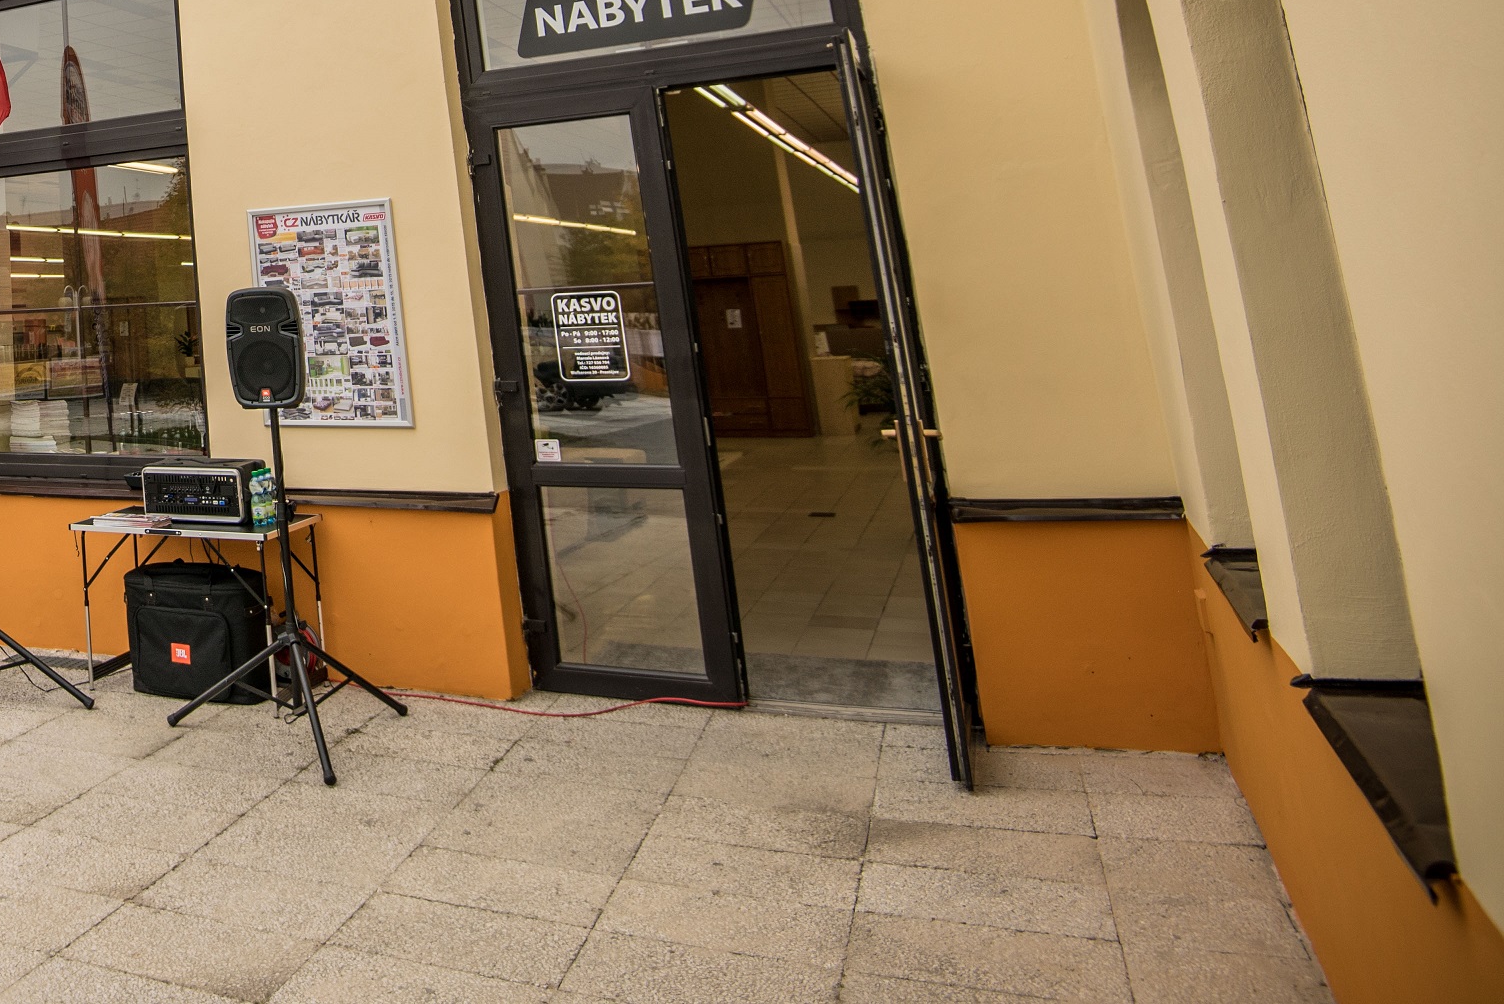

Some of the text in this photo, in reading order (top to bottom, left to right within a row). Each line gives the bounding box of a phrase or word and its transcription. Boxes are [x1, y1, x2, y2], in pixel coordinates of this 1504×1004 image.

[283, 209, 361, 228] CZ NÁBYTKÁŘ
[364, 213, 385, 221] KASVO
[556, 297, 616, 313] KASVO
[558, 312, 618, 325] NÁBYTEK
[250, 325, 271, 333] EON
